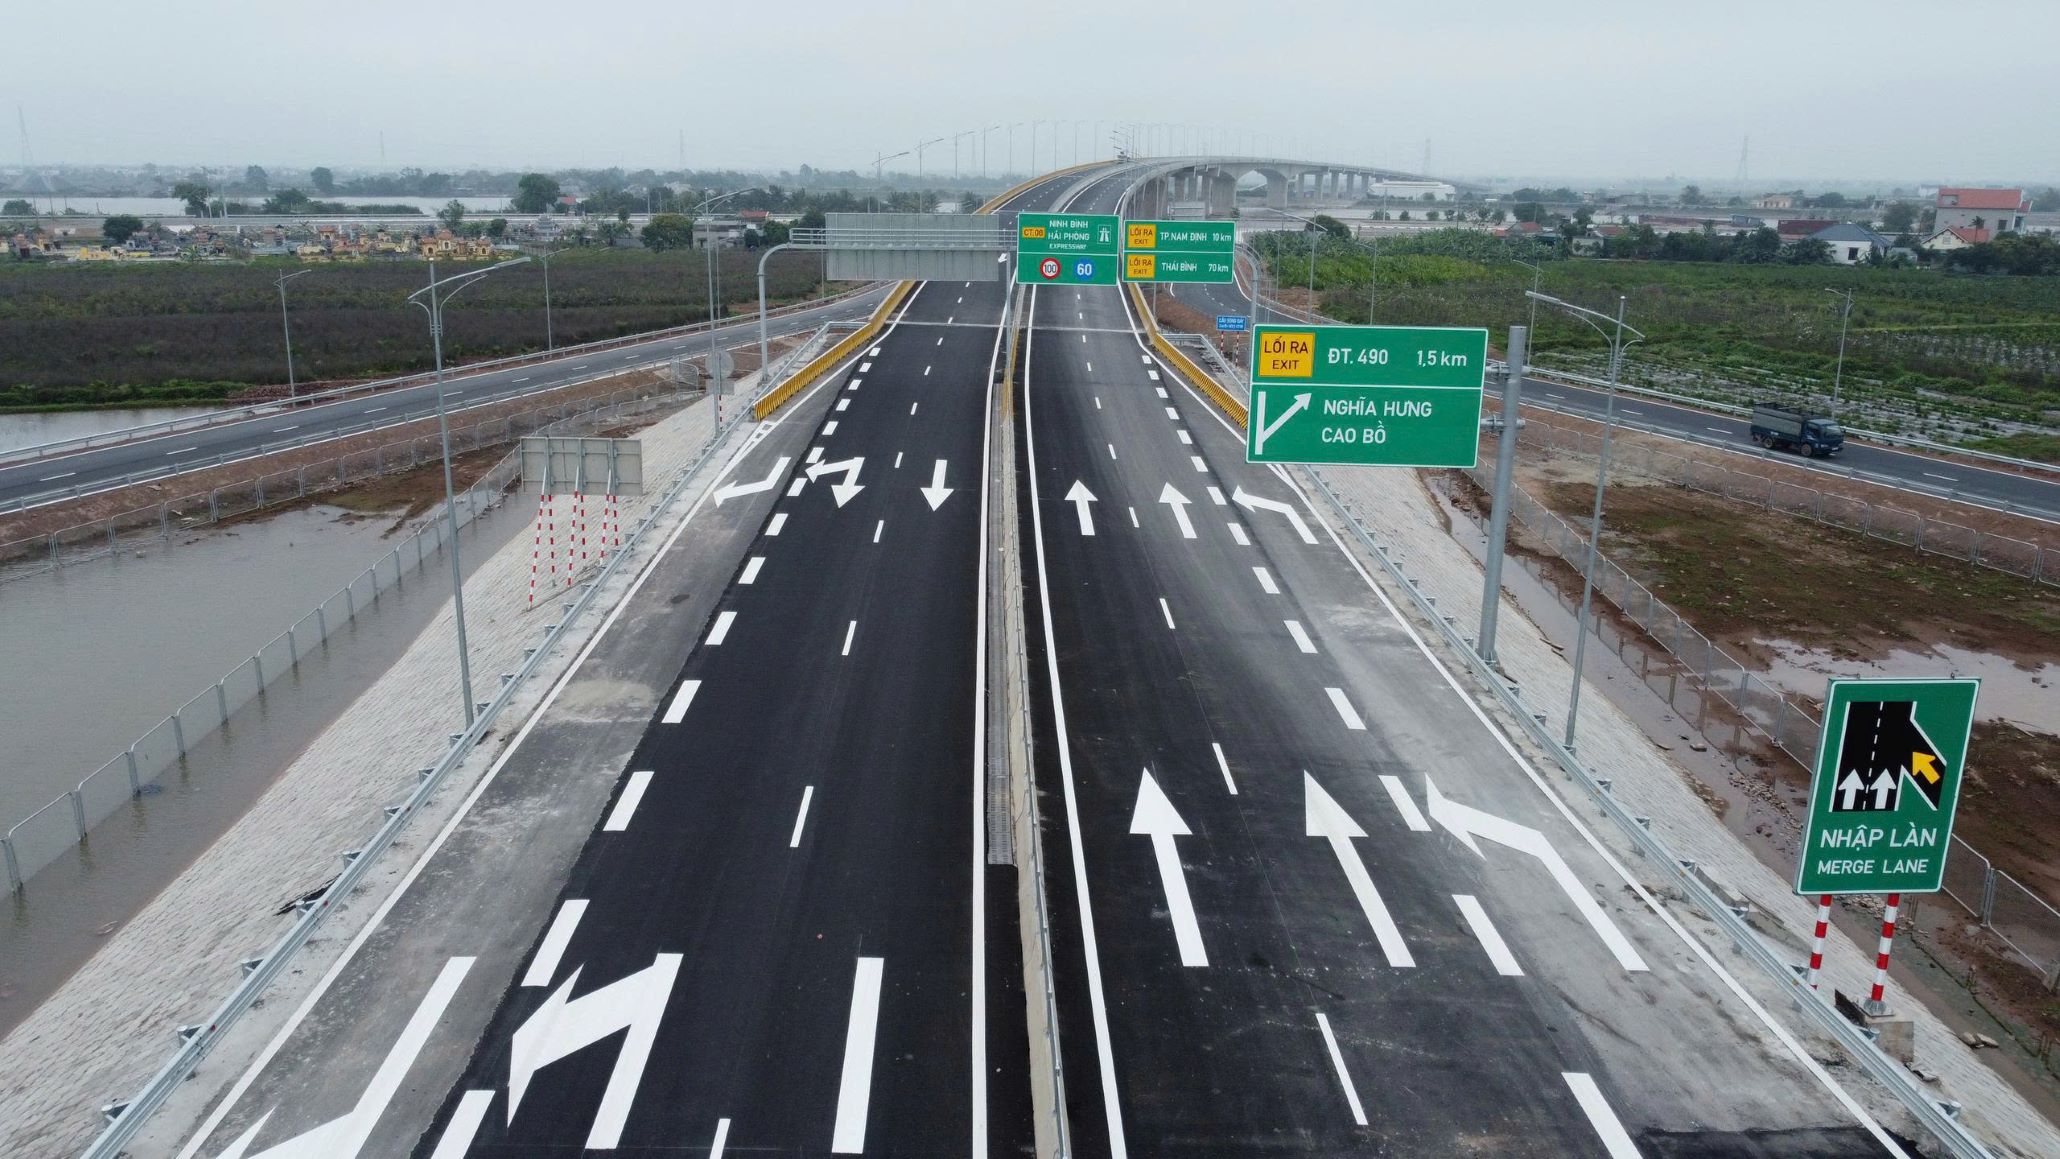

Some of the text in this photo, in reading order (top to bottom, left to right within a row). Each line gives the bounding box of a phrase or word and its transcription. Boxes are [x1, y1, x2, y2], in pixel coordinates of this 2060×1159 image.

[1049, 218, 1089, 228] NINH BÌNH
[1048, 230, 1090, 241] HẢI PHÒNG
[1130, 226, 1153, 236] LỐI RA
[1189, 232, 1207, 243] ĐỊNH
[1212, 233, 1220, 241] 10
[1220, 233, 1232, 242] km
[1129, 256, 1141, 266] LỐI
[1161, 259, 1229, 272] THÁI BÌNH 70 km
[1044, 264, 1057, 273] 100
[1076, 263, 1093, 276] 60
[1264, 336, 1309, 354] LỐI RA
[1272, 359, 1300, 370] EXIT
[1327, 348, 1467, 368] ĐT. 490 1,5 km
[1323, 396, 1433, 417] NGHĨA HƯNG
[1321, 420, 1387, 444] CAO BỒ
[1820, 821, 1938, 851] NHẬP LÀN
[1817, 858, 1929, 875] MERGE LANE
